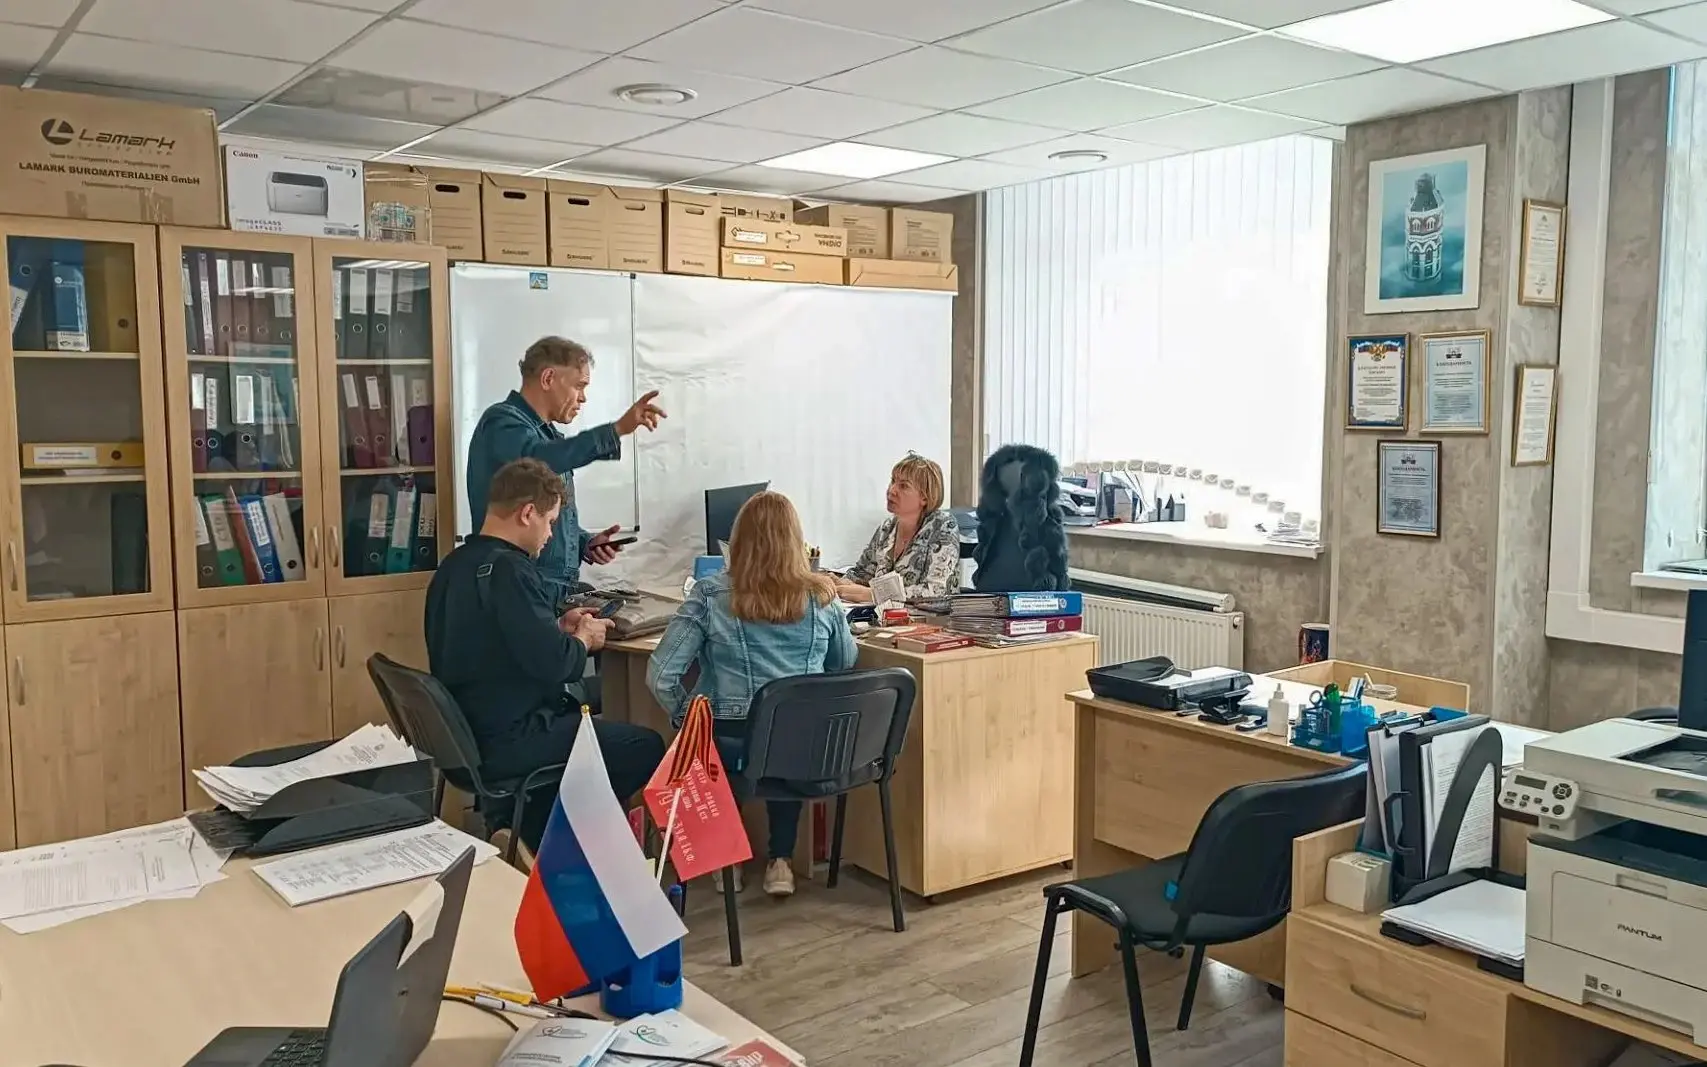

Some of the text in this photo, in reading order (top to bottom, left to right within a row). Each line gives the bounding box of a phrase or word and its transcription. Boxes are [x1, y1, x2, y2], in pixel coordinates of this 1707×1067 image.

[79, 128, 176, 150] Lamark
[232, 150, 259, 159] Canon
[18, 161, 66, 174] LAMARK
[171, 174, 200, 186] GmbH
[1617, 922, 1663, 941] PANTUM
